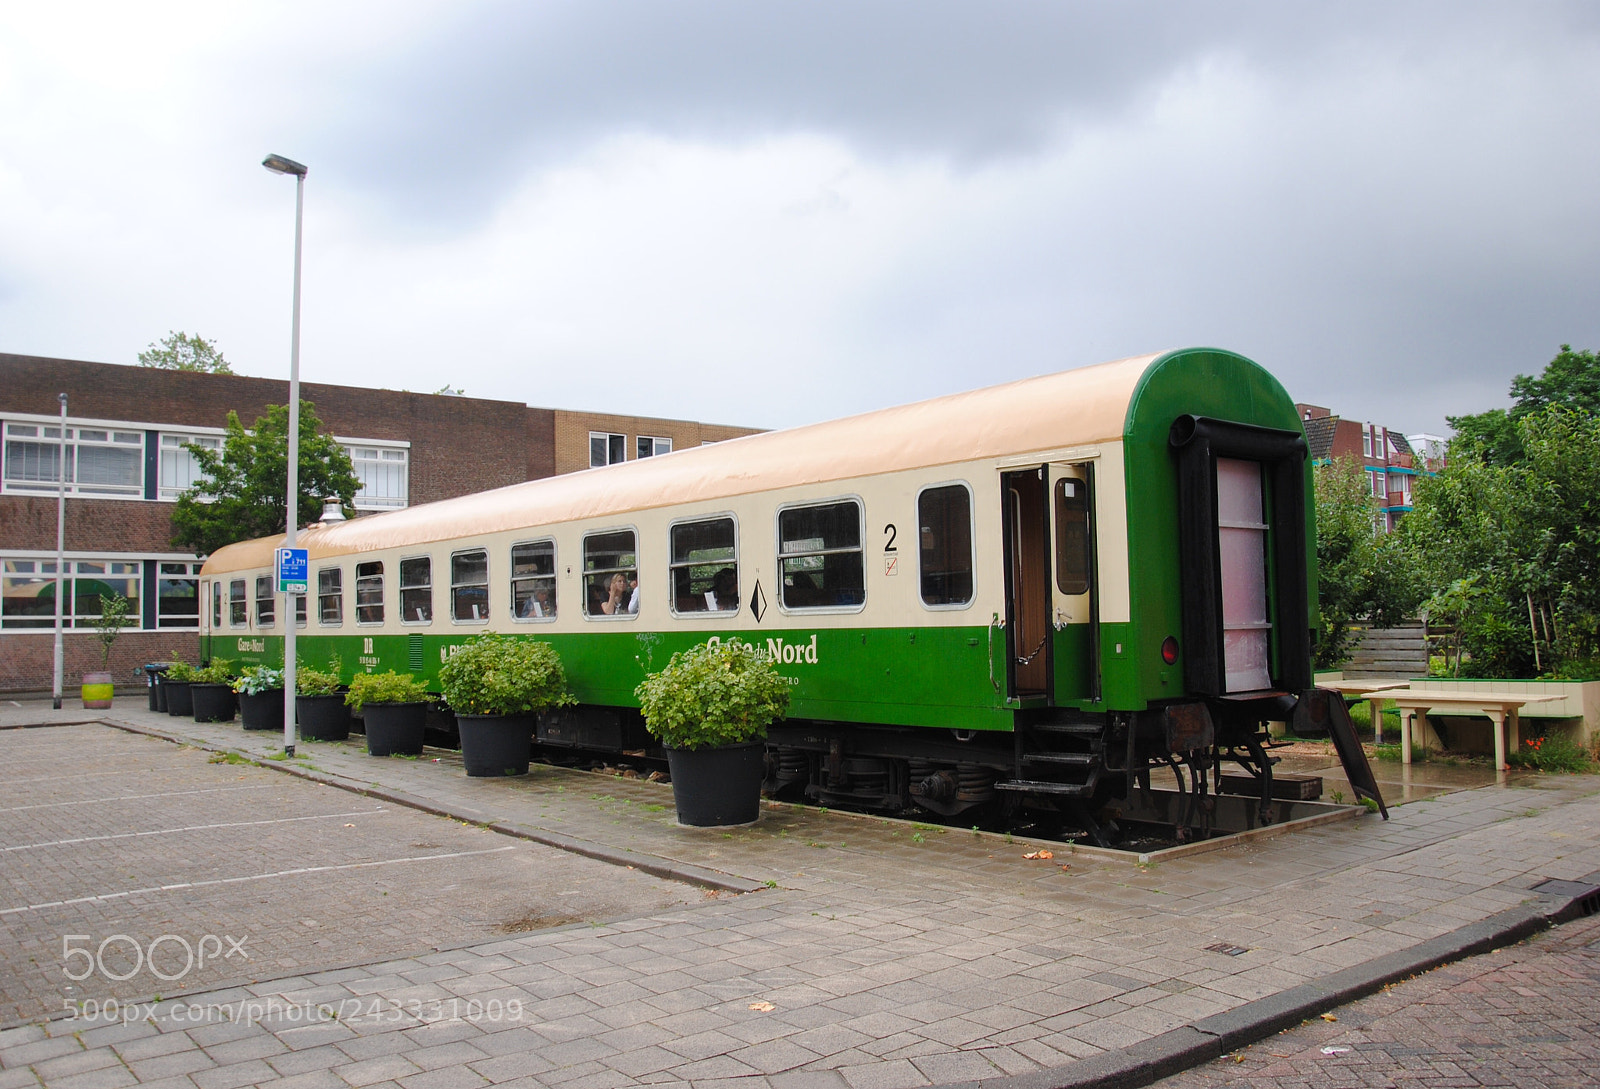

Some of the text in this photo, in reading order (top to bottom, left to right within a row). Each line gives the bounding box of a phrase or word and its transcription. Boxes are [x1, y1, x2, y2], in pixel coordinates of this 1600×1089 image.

[884, 523, 897, 552] 2
[363, 637, 373, 654] DR
[766, 634, 818, 664] Nord
